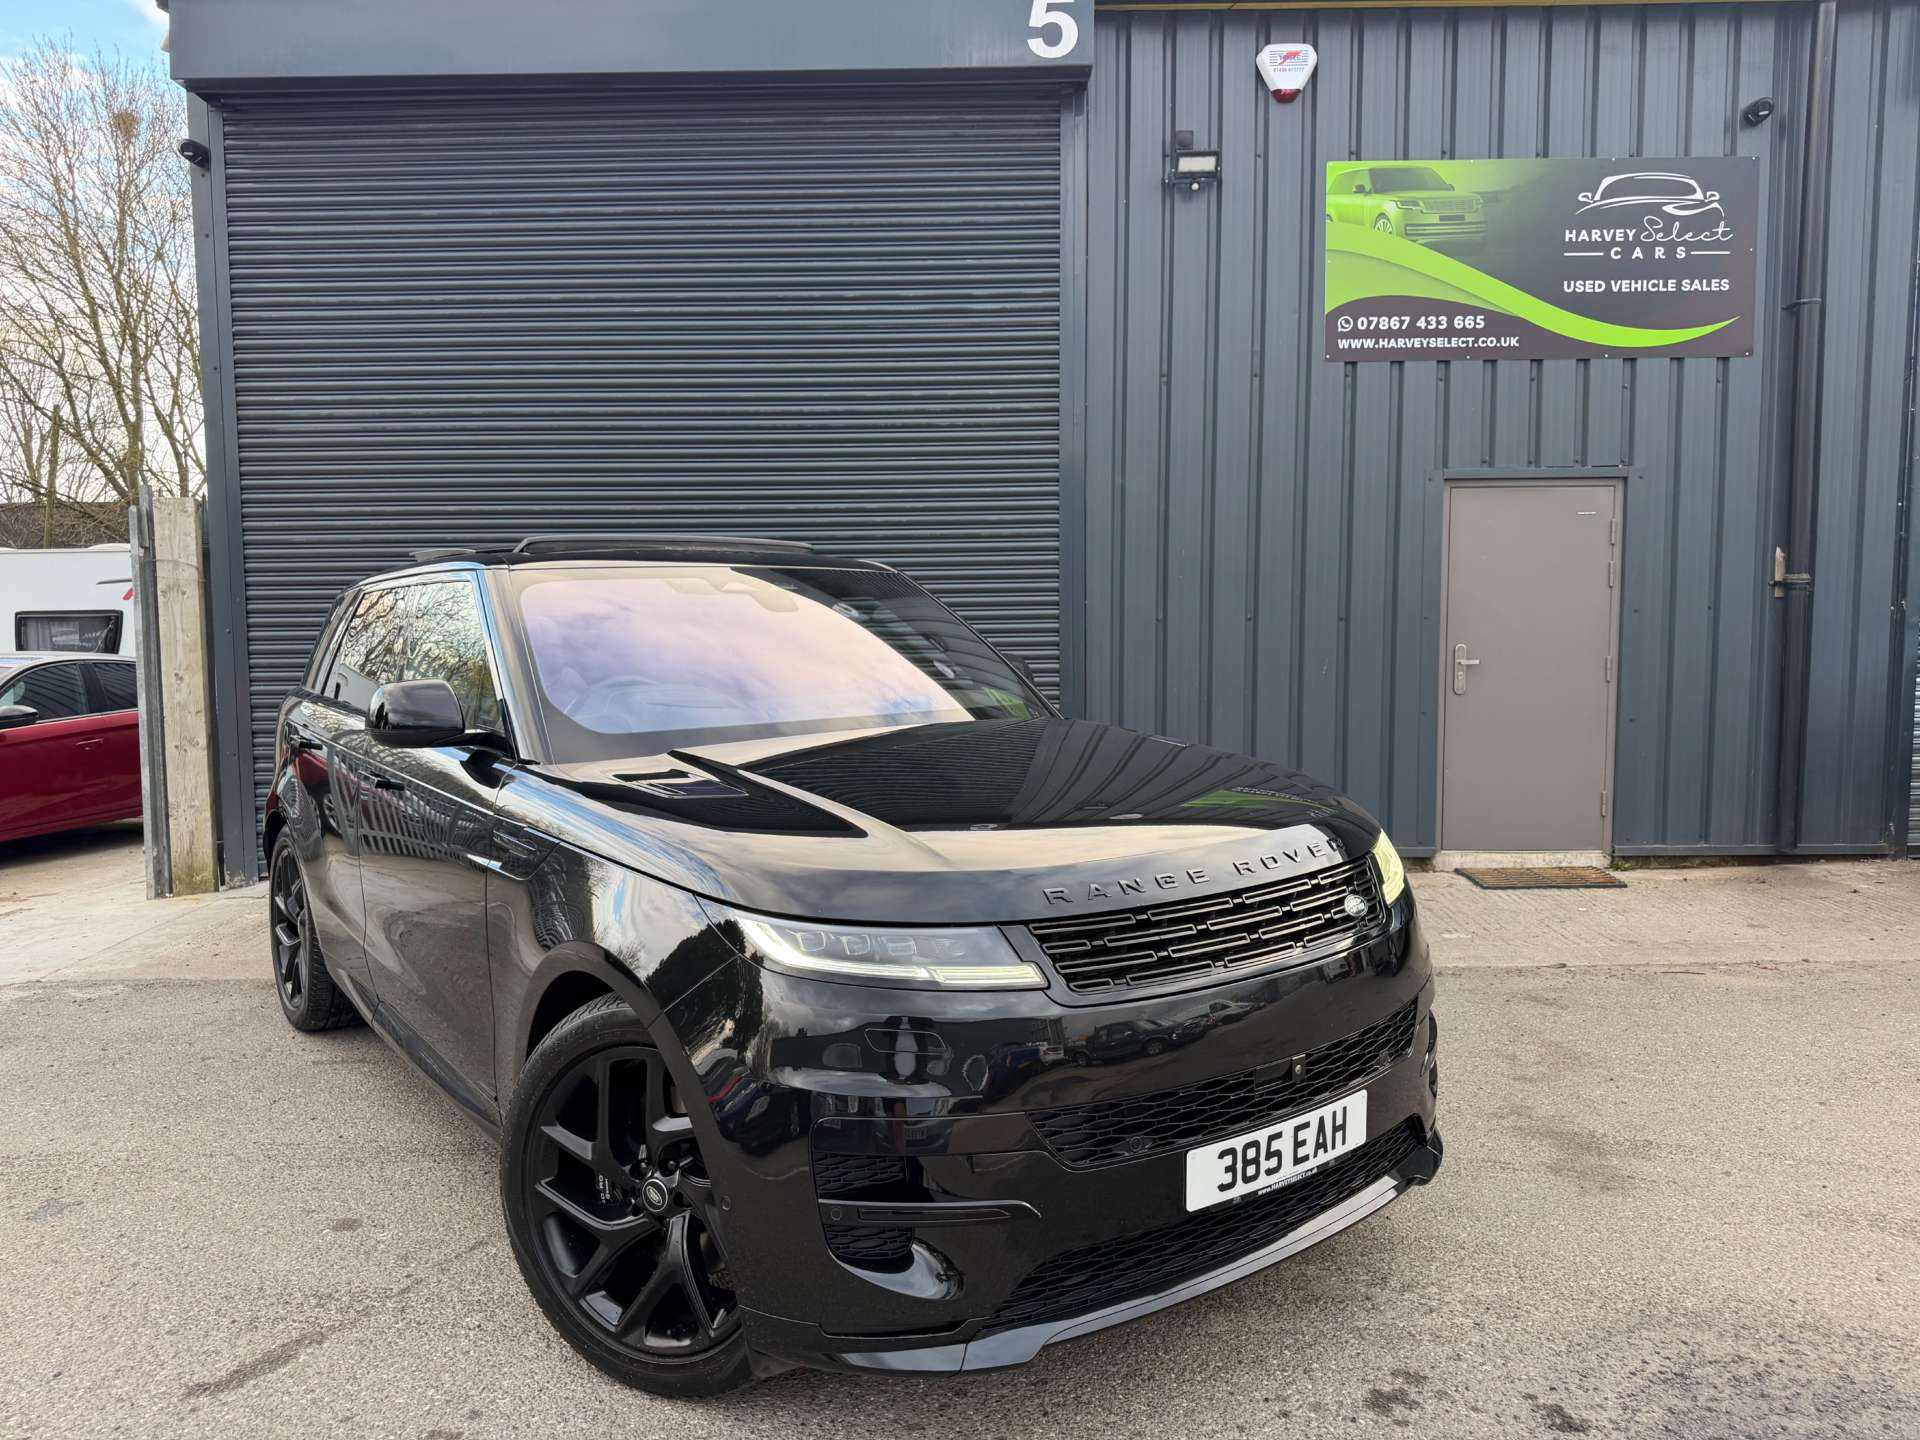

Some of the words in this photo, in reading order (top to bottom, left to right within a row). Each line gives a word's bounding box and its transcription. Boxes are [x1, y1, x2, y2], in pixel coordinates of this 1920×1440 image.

[1026, 0, 1079, 59] 5
[1564, 228, 1637, 242] HARVEY
[1640, 215, 1734, 242] Select
[1610, 246, 1687, 260] CARS
[1563, 280, 1606, 293] USED
[1611, 279, 1677, 292] VEHICLE
[1681, 278, 1730, 292] SALES
[1357, 316, 1411, 330] 07867
[1416, 315, 1448, 330] 433
[1453, 315, 1486, 329] 665
[1337, 336, 1520, 349] WWW.HARVEYSELECT.CO.UK
[1042, 866, 1211, 905] RANGE
[1216, 1131, 1283, 1193] 385
[1293, 1106, 1347, 1167] EAH
